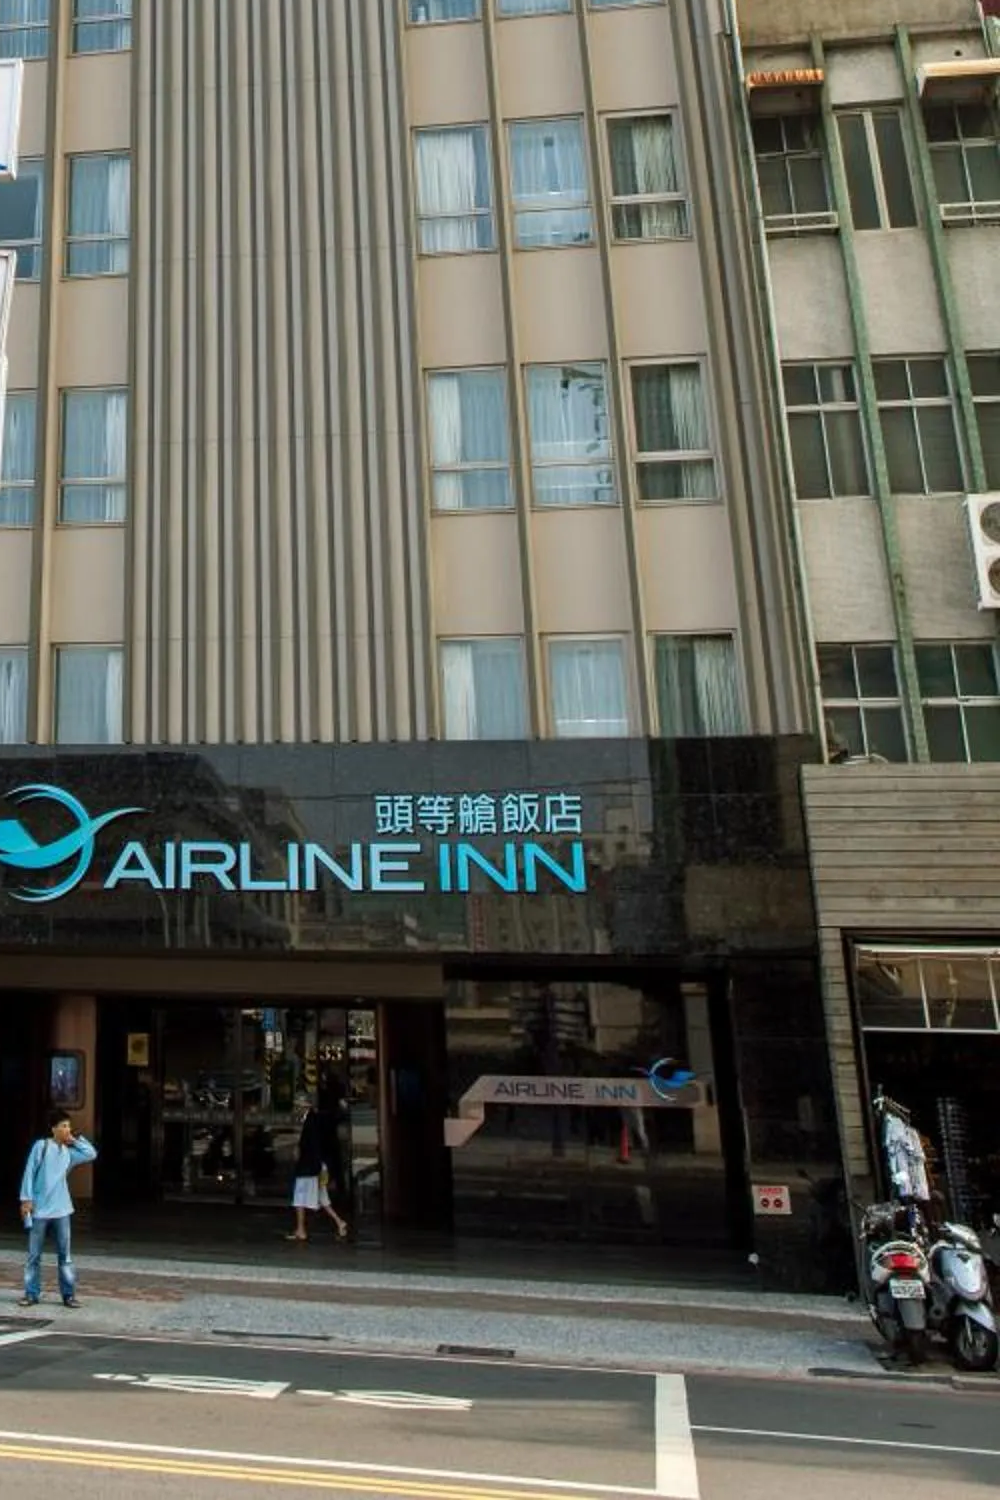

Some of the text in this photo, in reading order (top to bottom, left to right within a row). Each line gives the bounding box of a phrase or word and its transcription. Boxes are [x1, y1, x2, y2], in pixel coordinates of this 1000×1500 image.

[375, 794, 583, 835] 頭等艙飯店
[103, 841, 587, 892] AIRLINE INN
[493, 1082, 637, 1100] AIRLINE INN
